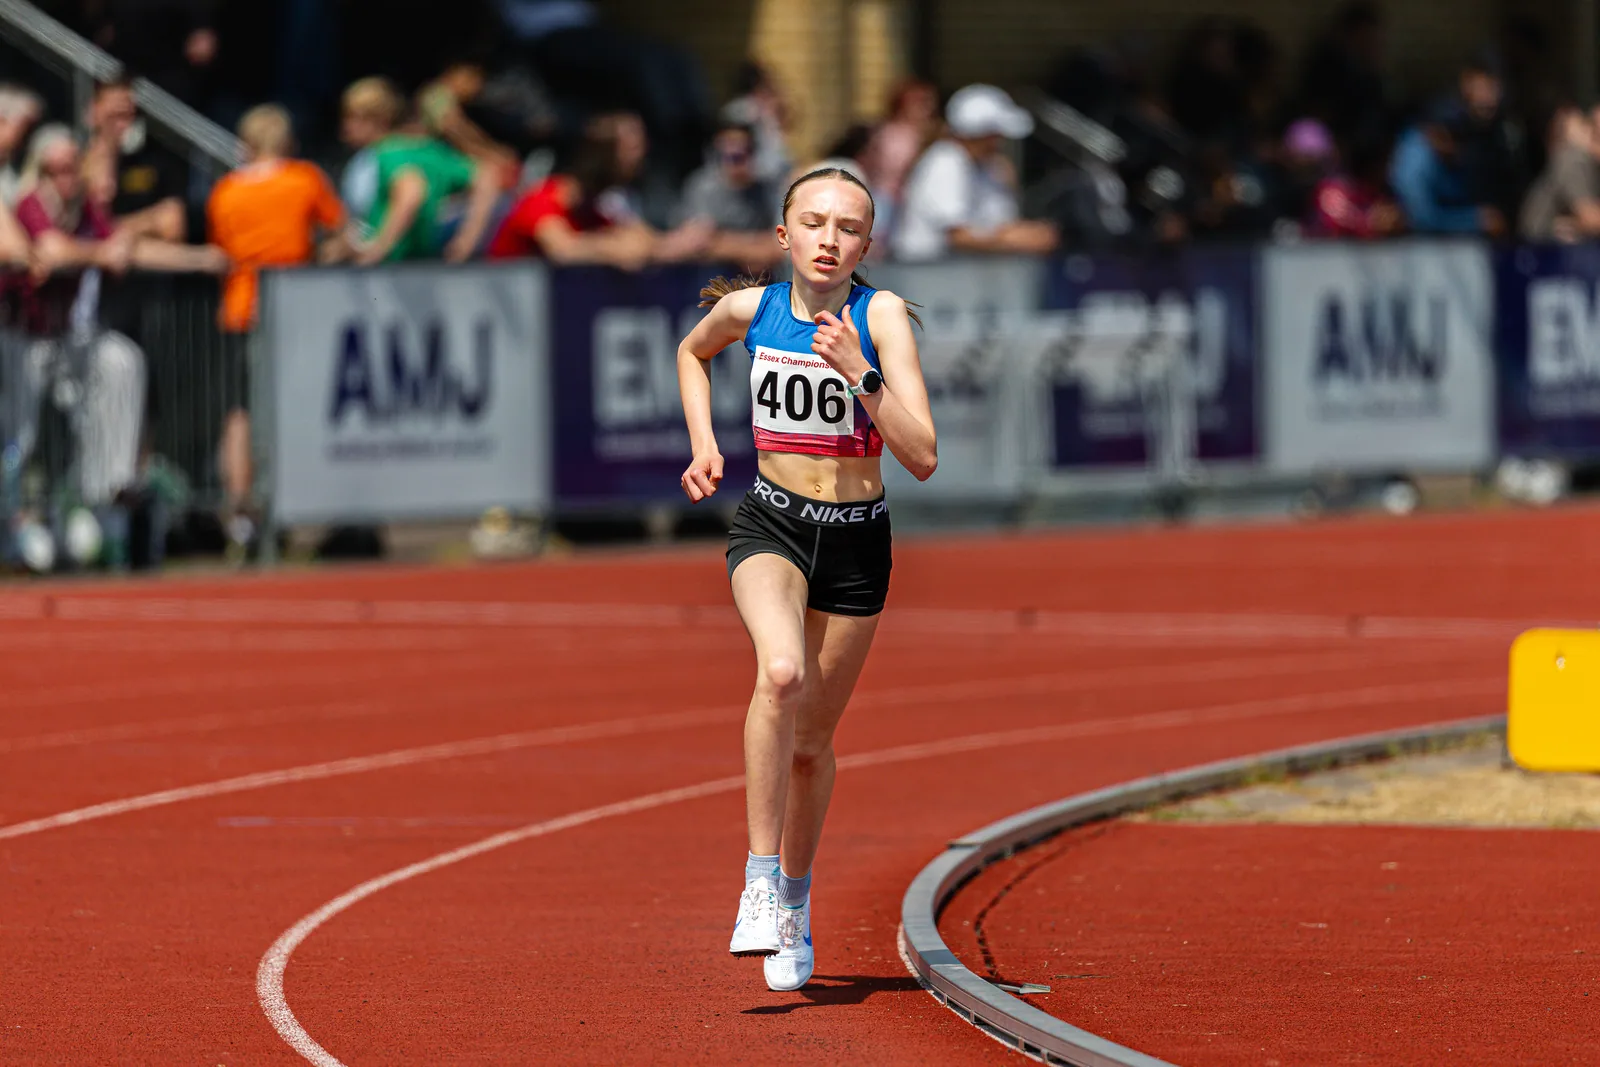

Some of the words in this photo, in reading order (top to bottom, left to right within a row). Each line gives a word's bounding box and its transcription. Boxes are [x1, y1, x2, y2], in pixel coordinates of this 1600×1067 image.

[759, 352, 780, 363] Essex
[781, 356, 833, 369] Champions
[1313, 292, 1449, 383] AMJ
[328, 318, 494, 427] AMJ
[757, 370, 846, 424] 406
[800, 503, 867, 523] NIKE
[871, 499, 887, 520] P
